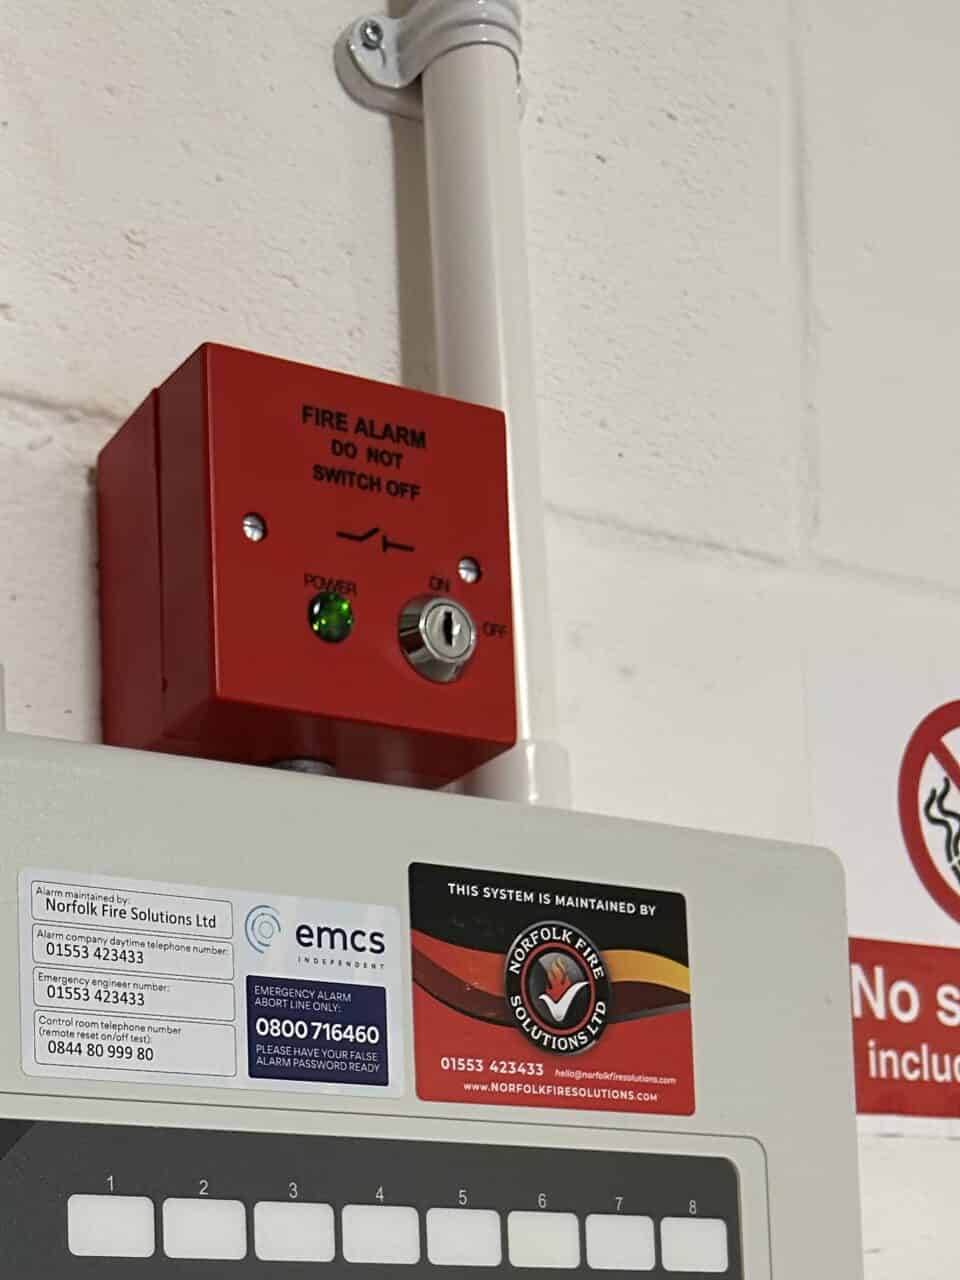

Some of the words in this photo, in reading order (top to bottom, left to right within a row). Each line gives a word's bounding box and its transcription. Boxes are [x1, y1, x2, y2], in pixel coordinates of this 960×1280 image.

[302, 405, 348, 431] FIRE
[355, 417, 426, 449] ALARM
[332, 440, 357, 460] DO
[367, 447, 403, 469] NOT
[313, 464, 381, 493] SWITCH
[386, 479, 421, 500] OFF
[304, 574, 357, 596] POWER
[429, 575, 450, 593] ON
[483, 622, 508, 638] OFF
[448, 883, 479, 897] THIS
[484, 886, 534, 903] SYSTEM
[539, 893, 550, 904] IS
[556, 896, 636, 914] MAINTAINED
[640, 904, 656, 916] BY
[46, 898, 97, 916] Norfolk
[102, 905, 127, 919] Fire
[131, 907, 192, 926] Solutions
[196, 914, 216, 928] Ltd
[296, 924, 385, 953] emcs
[46, 943, 89, 959] 01553
[94, 947, 144, 964] 423433
[298, 957, 385, 969] INDEPENDENT
[508, 927, 572, 974] NORFOLK
[575, 936, 605, 980] FIRE
[47, 985, 90, 1001] 01553
[94, 990, 144, 1006] 423433
[254, 985, 315, 999] EMERGENCY
[317, 991, 351, 1002] ALARM
[254, 997, 288, 1008] ABORT
[291, 1000, 311, 1010] LINE
[850, 963, 920, 1023] No
[256, 1018, 308, 1038] 0800
[311, 1023, 379, 1043] 716460
[510, 996, 588, 1050] SOLUTIONS
[587, 1001, 606, 1034] LTD
[48, 1040, 82, 1056] 0844
[87, 1044, 103, 1057] 80
[108, 1045, 133, 1059] 999
[137, 1047, 153, 1061] 80
[256, 1044, 291, 1055] PLEASE
[294, 1048, 319, 1058] HAVE
[321, 1050, 348, 1059] YOUR
[350, 1051, 377, 1061] FALSE
[256, 1056, 291, 1067] ALARM
[293, 1059, 347, 1071] PASSWORD
[349, 1061, 380, 1072] READY
[440, 1057, 484, 1072] 01553
[490, 1062, 544, 1076] 423433
